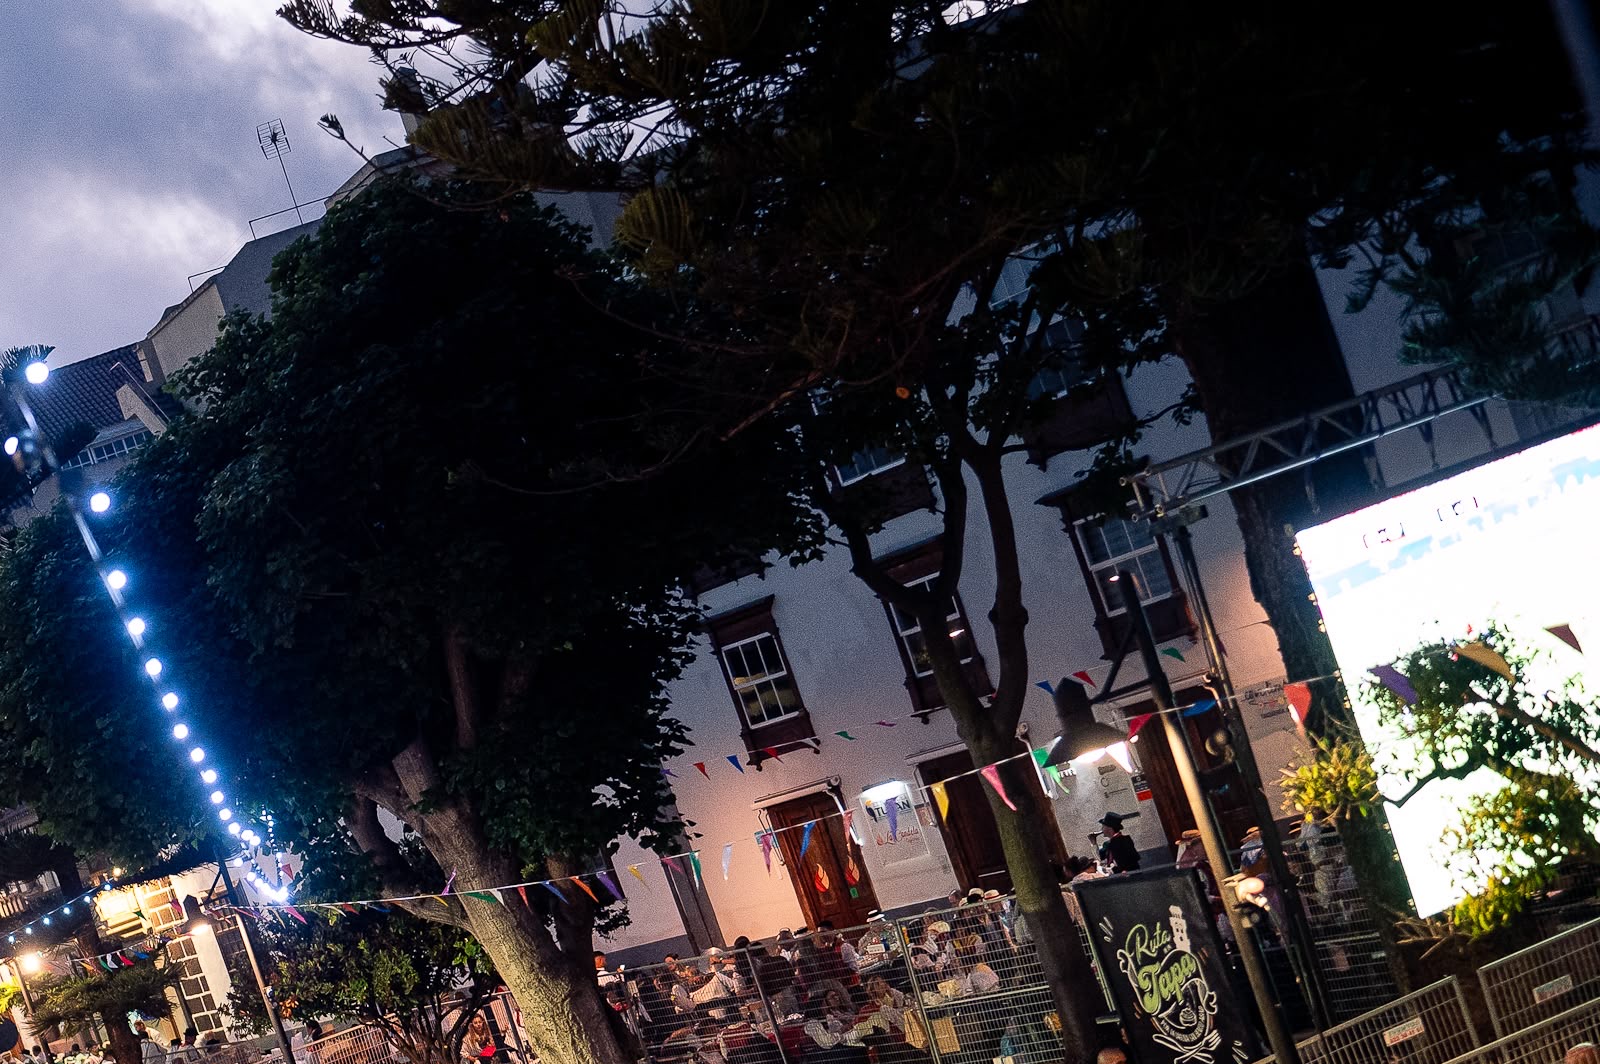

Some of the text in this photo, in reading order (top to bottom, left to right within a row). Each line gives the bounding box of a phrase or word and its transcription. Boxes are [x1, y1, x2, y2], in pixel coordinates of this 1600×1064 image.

[874, 799, 911, 817] TUAN
[1125, 922, 1170, 965] Ruta
[1137, 953, 1197, 1014] Tapa
